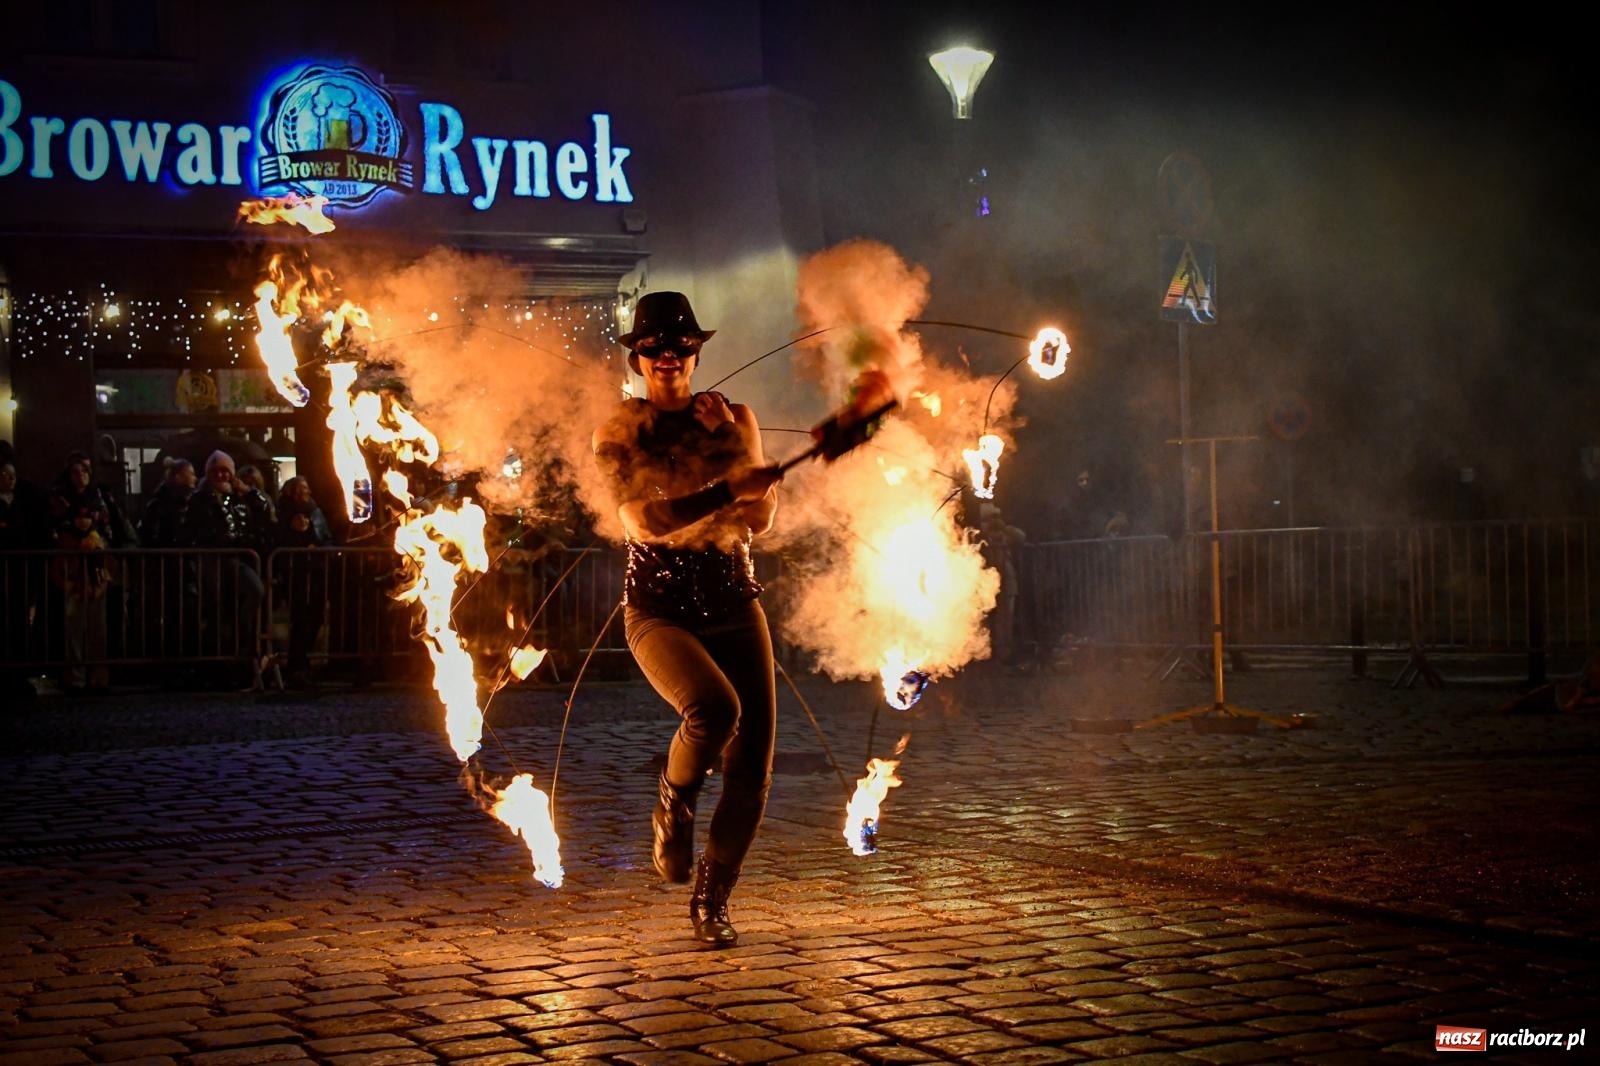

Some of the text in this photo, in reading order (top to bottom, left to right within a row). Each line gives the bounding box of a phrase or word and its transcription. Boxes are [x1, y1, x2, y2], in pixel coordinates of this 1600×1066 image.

[278, 154, 397, 183] Browar Rynek
[419, 103, 633, 210] Rynek
[336, 183, 358, 195] 2013
